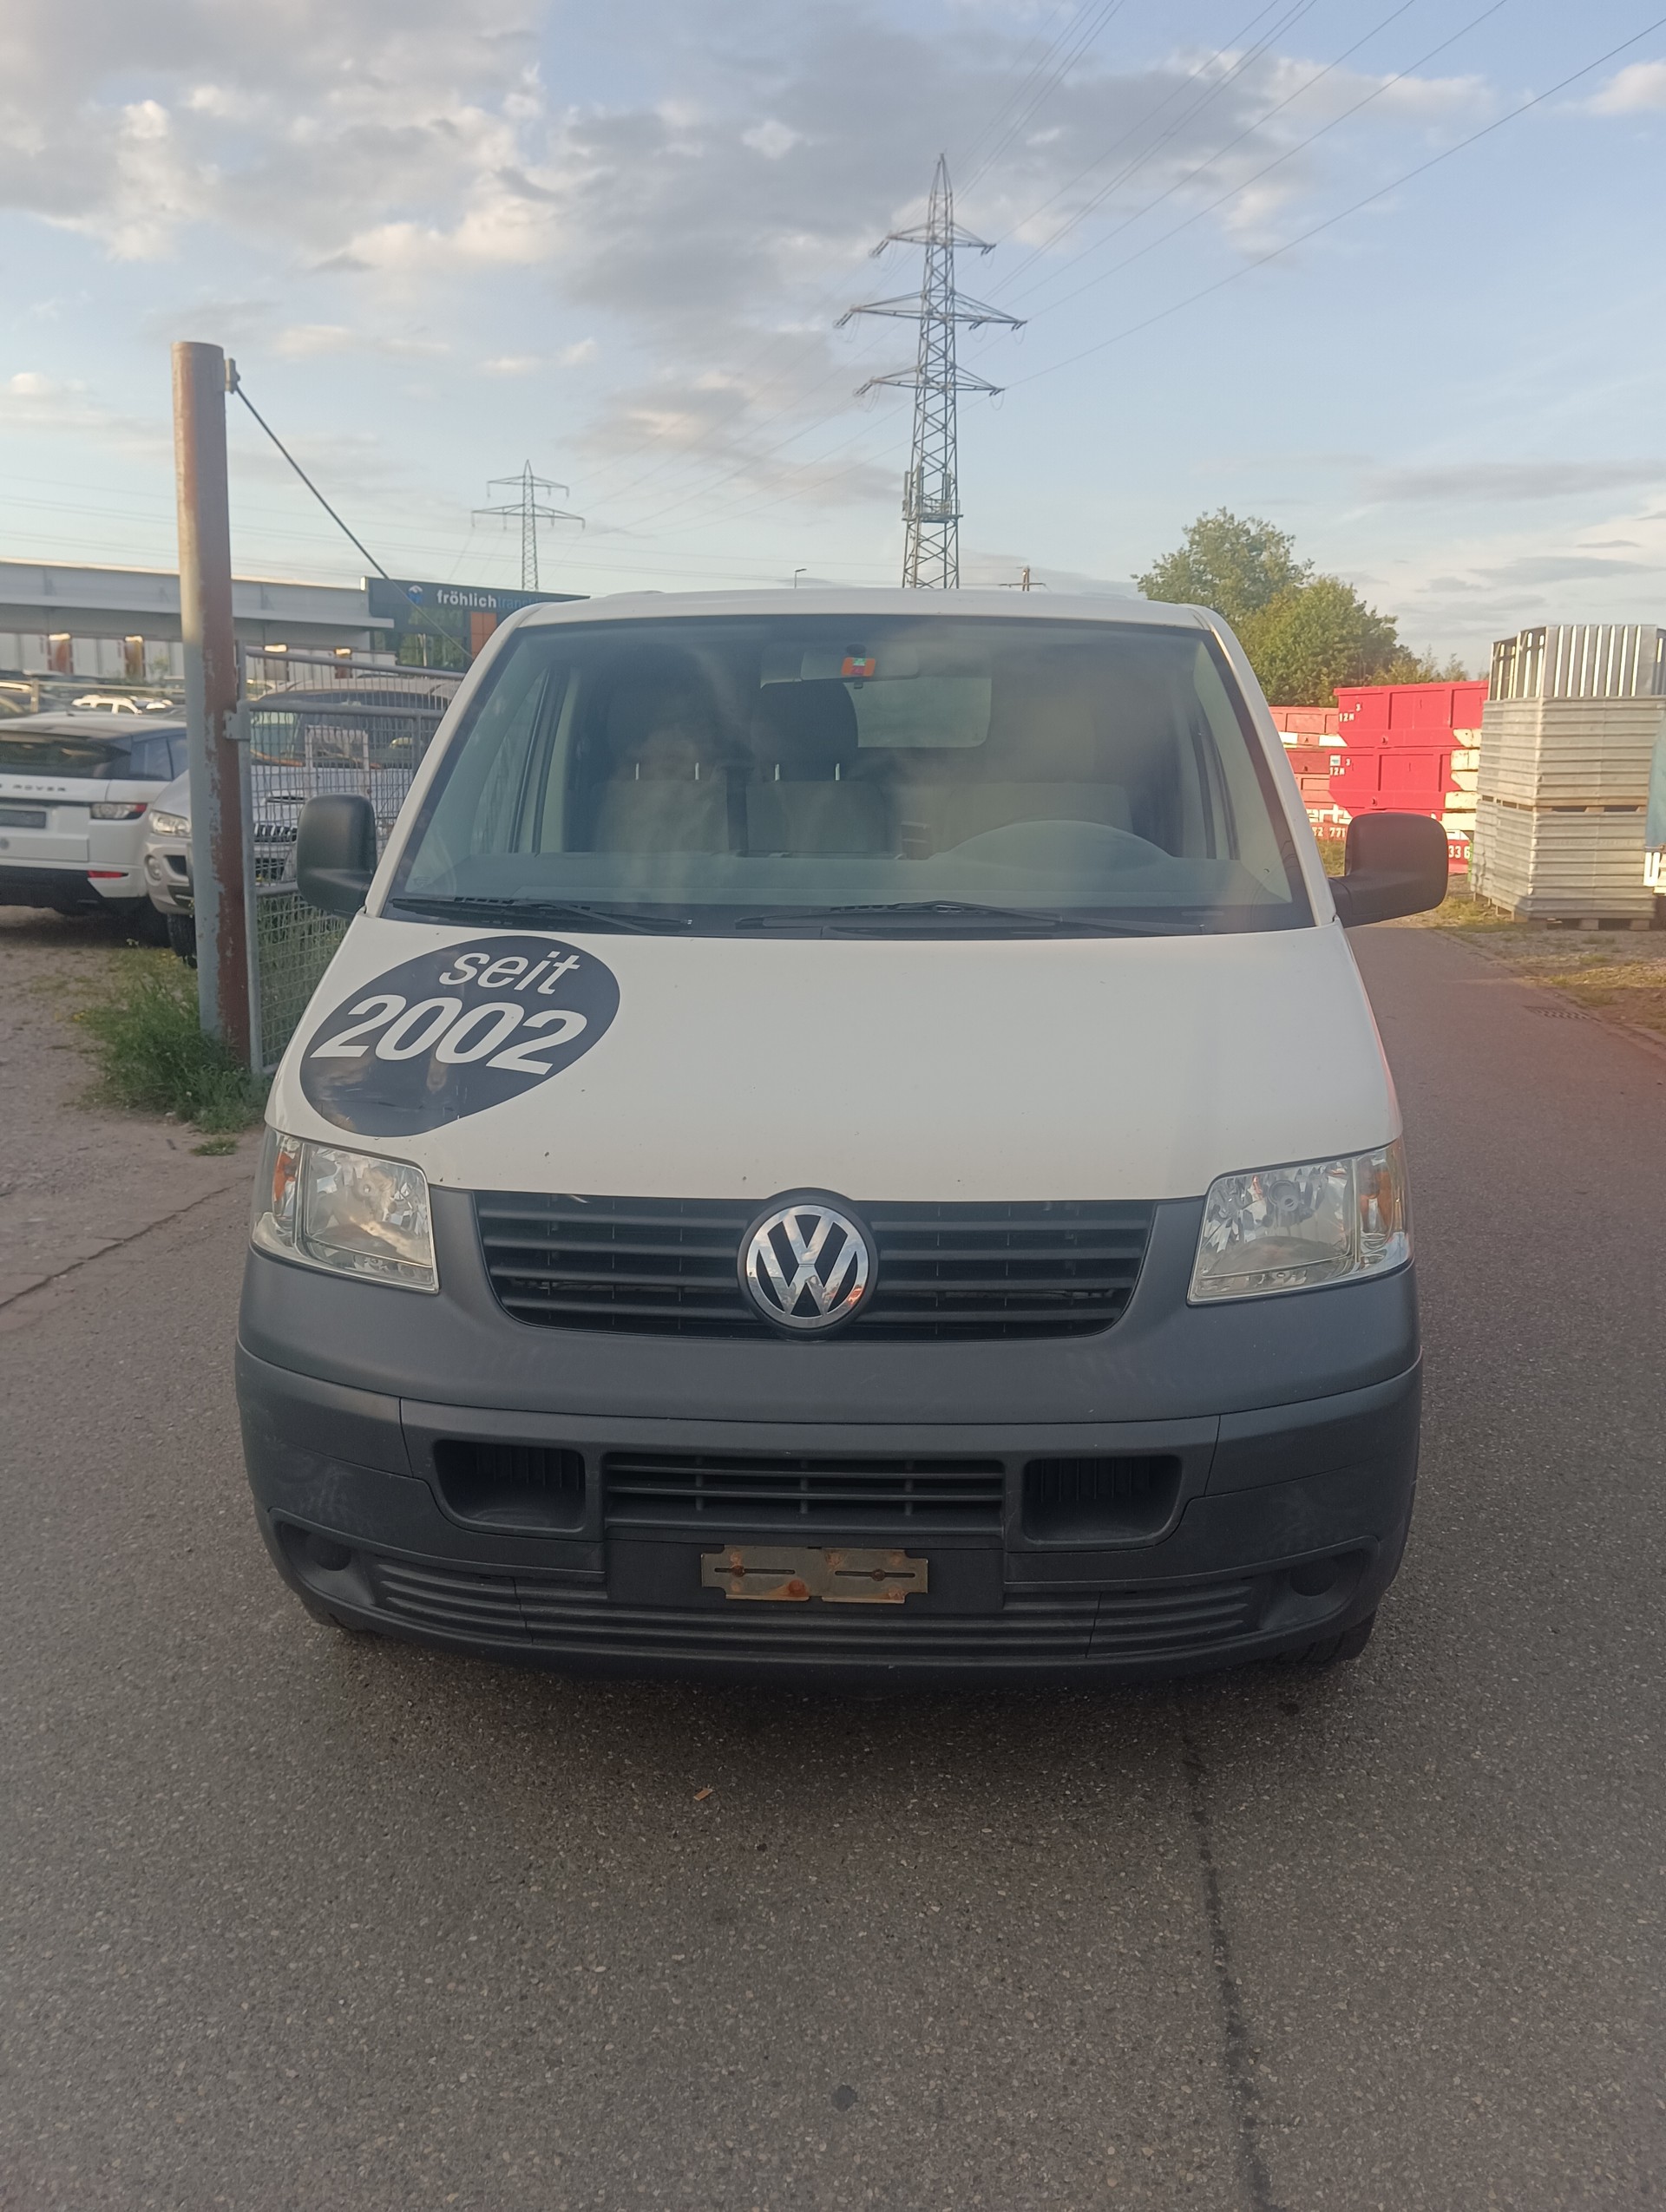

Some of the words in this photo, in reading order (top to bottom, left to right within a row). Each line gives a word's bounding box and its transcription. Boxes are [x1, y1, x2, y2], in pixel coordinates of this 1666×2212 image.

[437, 589, 497, 608] fröhlich
[439, 951, 580, 995] seit
[310, 994, 587, 1075] 2002
[747, 1205, 868, 1327] VW
